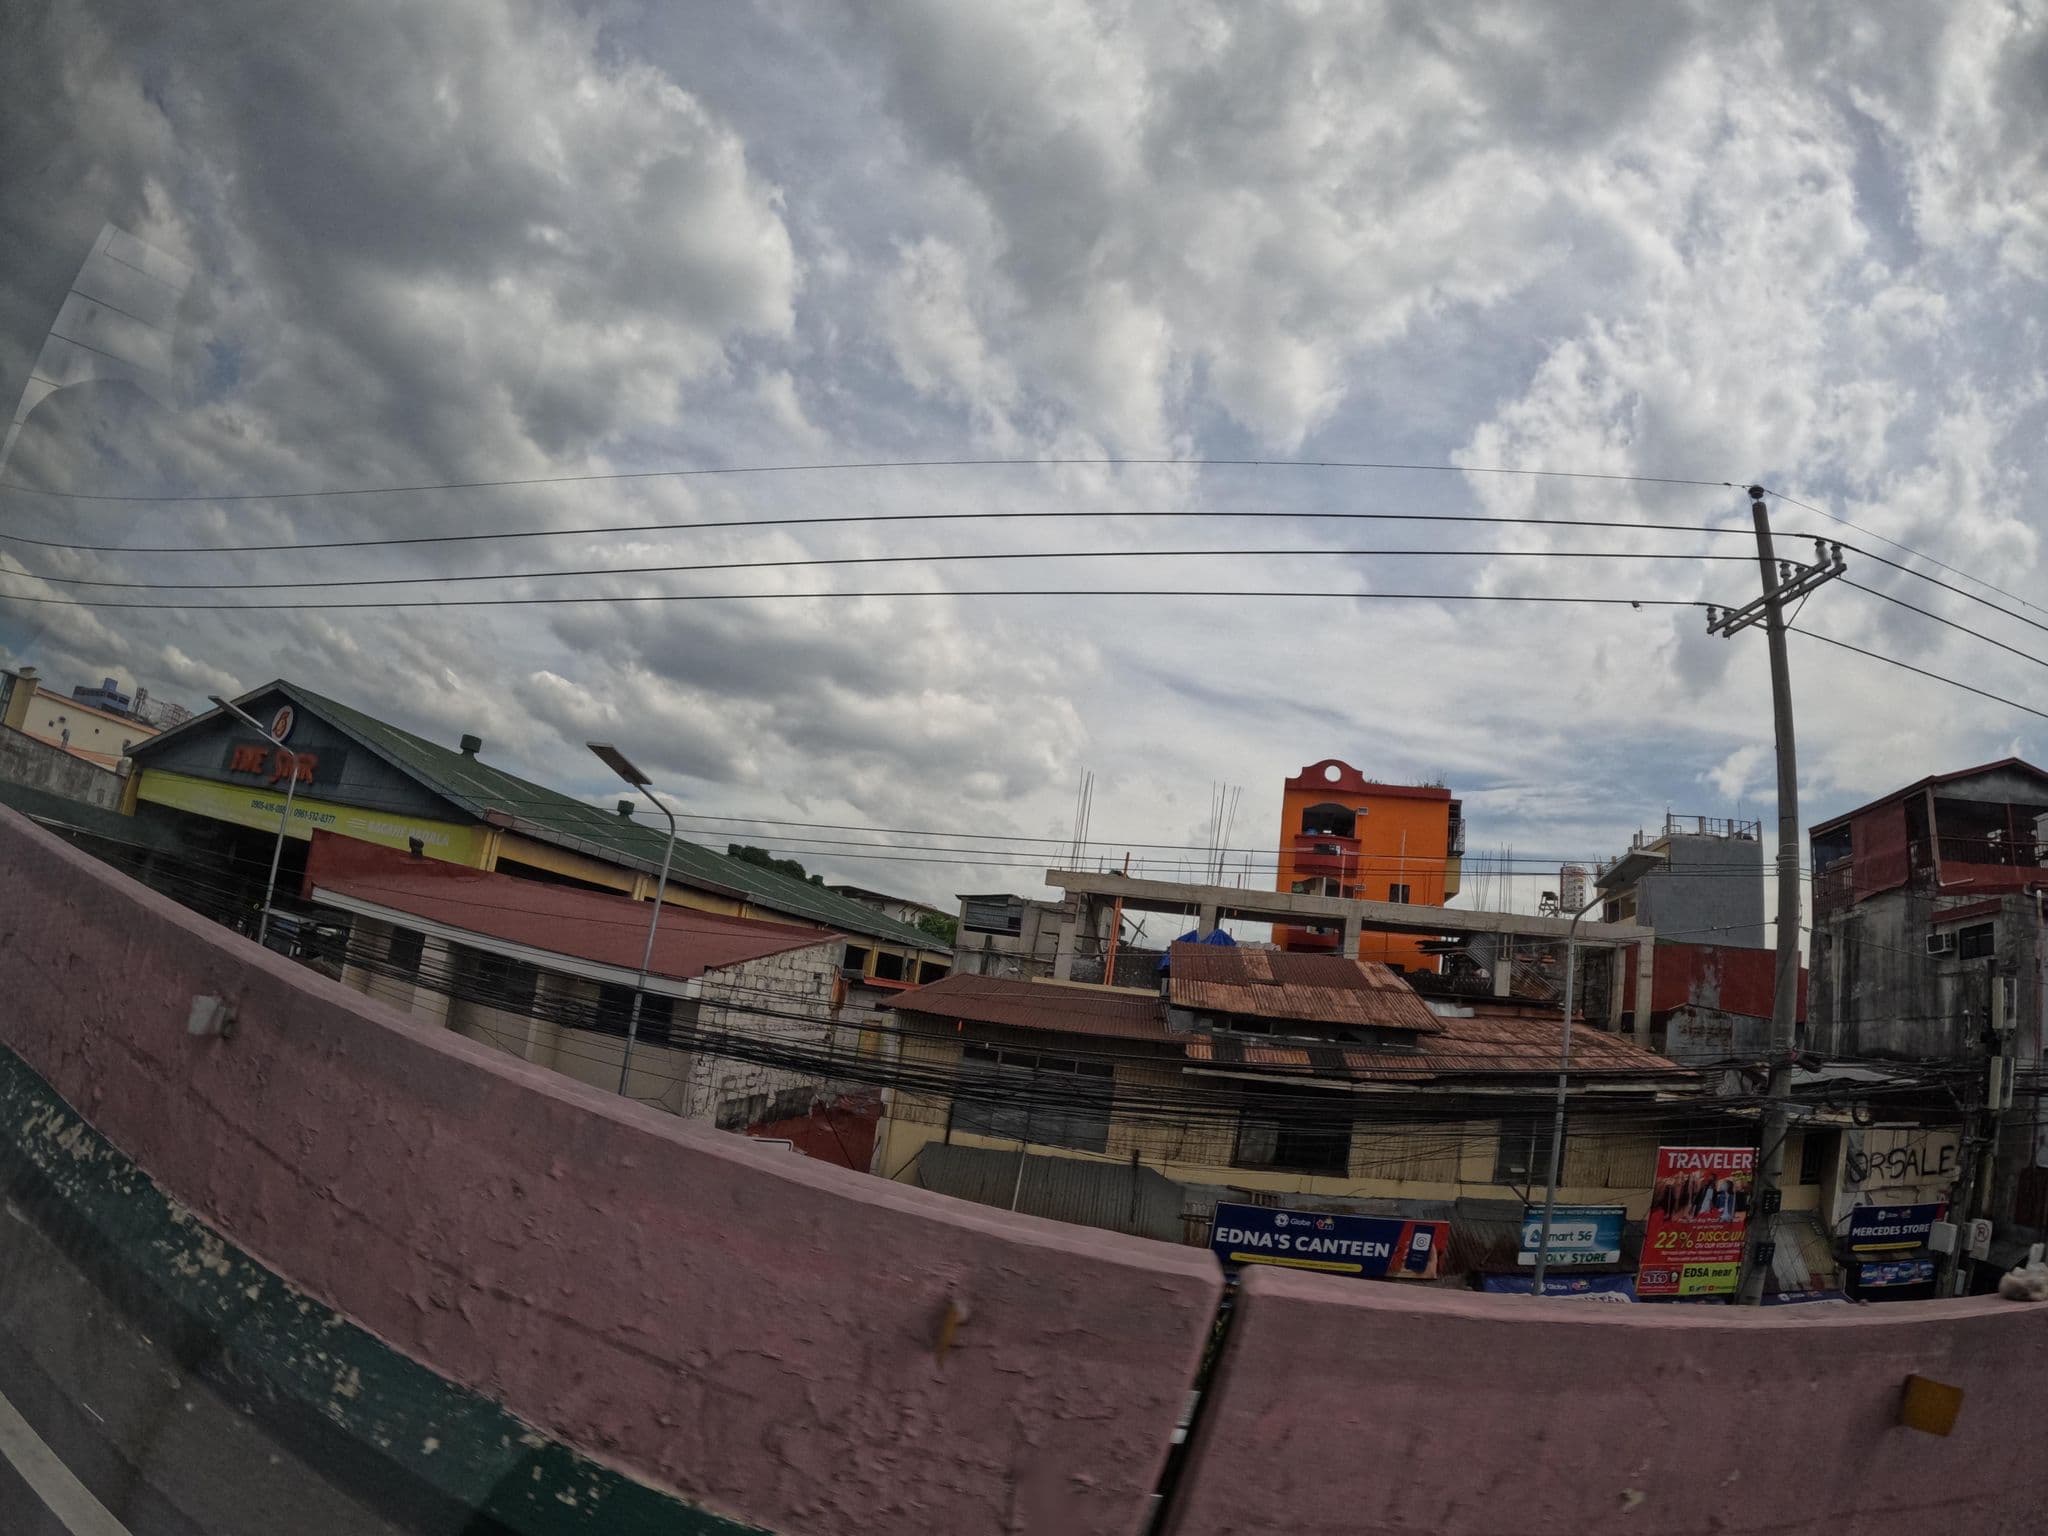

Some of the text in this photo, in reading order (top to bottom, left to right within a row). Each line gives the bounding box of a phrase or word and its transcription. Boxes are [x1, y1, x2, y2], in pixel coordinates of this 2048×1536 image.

[1852, 1223, 1931, 1236] MERCEDES STORE
[1215, 1226, 1391, 1258] EDNA'S CANTEEN
[1546, 1230, 1574, 1242] mart
[1655, 1231, 1694, 1249] 22%
[1572, 1252, 1607, 1263] STORE
[1683, 1267, 1709, 1278] EDSA
[1712, 1268, 1732, 1277] near
